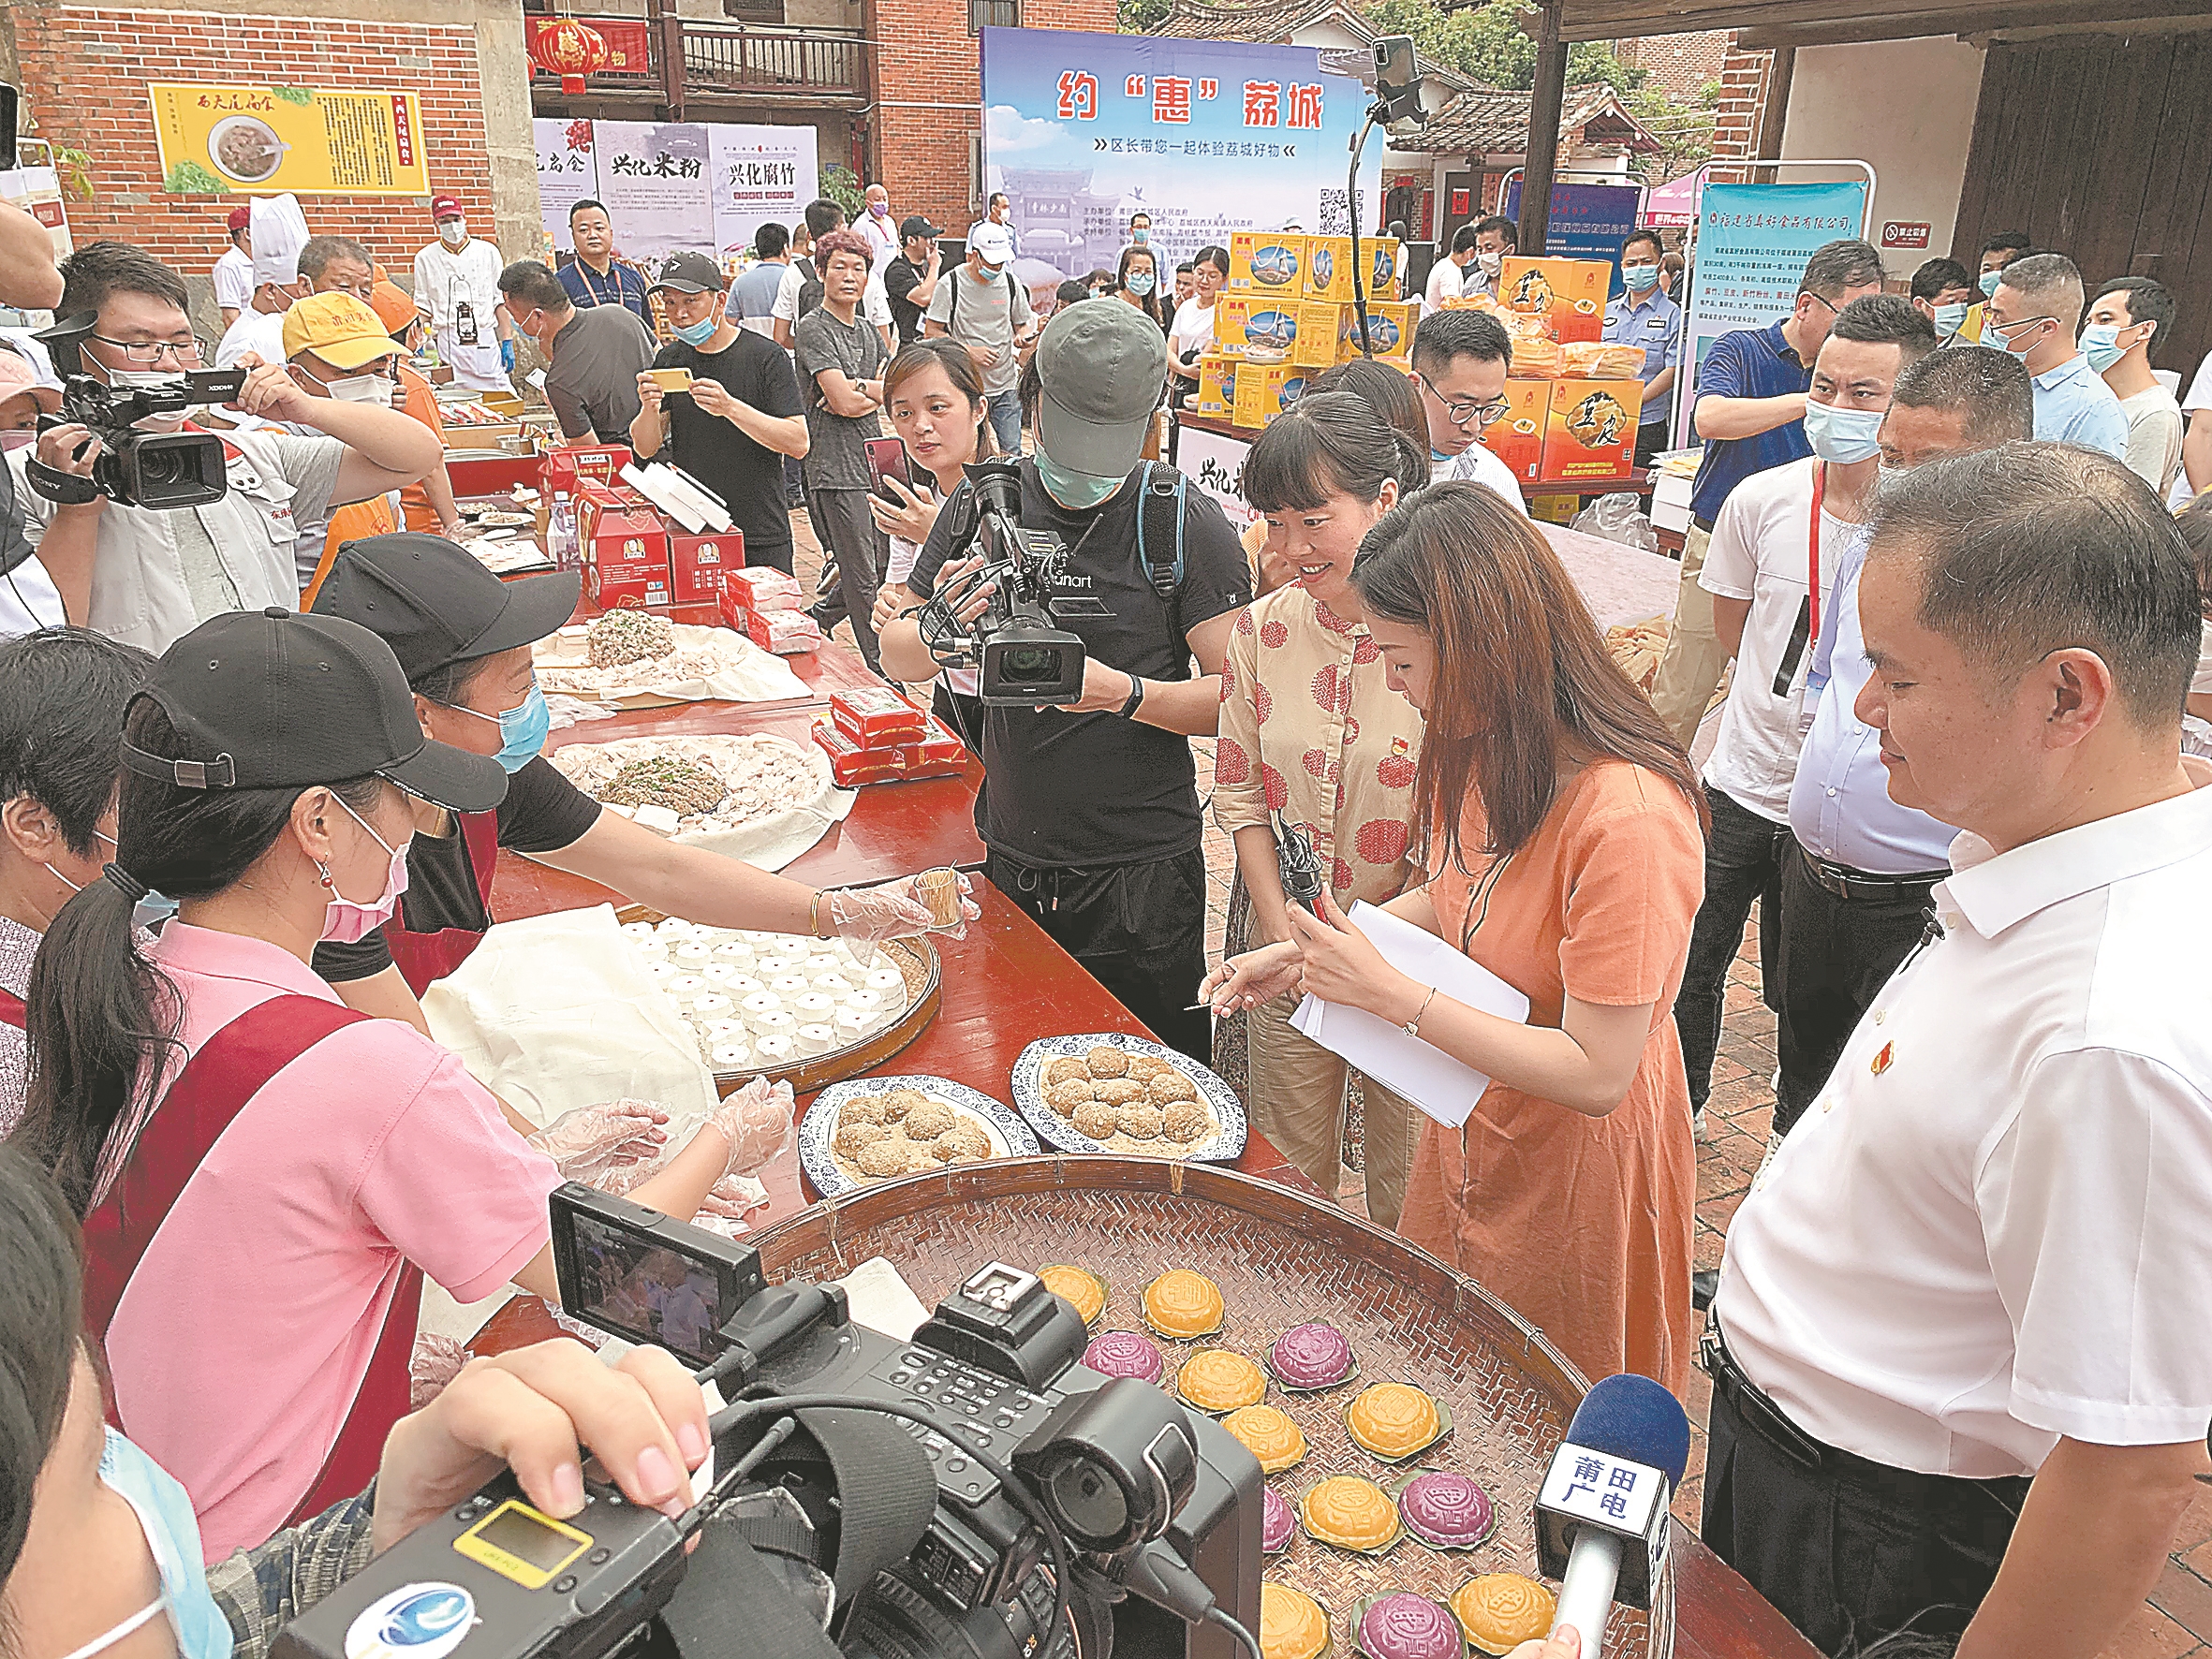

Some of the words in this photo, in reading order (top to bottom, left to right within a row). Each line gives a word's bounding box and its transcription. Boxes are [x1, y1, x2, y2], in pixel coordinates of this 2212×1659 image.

[1111, 138, 1280, 158] 区长带您一起体验荔城好物
[611, 151, 702, 179] 兴化米粉
[729, 162, 796, 186] 兴化腐竹
[1720, 213, 1850, 231] 福建省真好食品有限公司
[1574, 396, 1620, 446] 豆皮
[1573, 1456, 1638, 1492] 莆田
[1561, 1483, 1628, 1520] 广电
